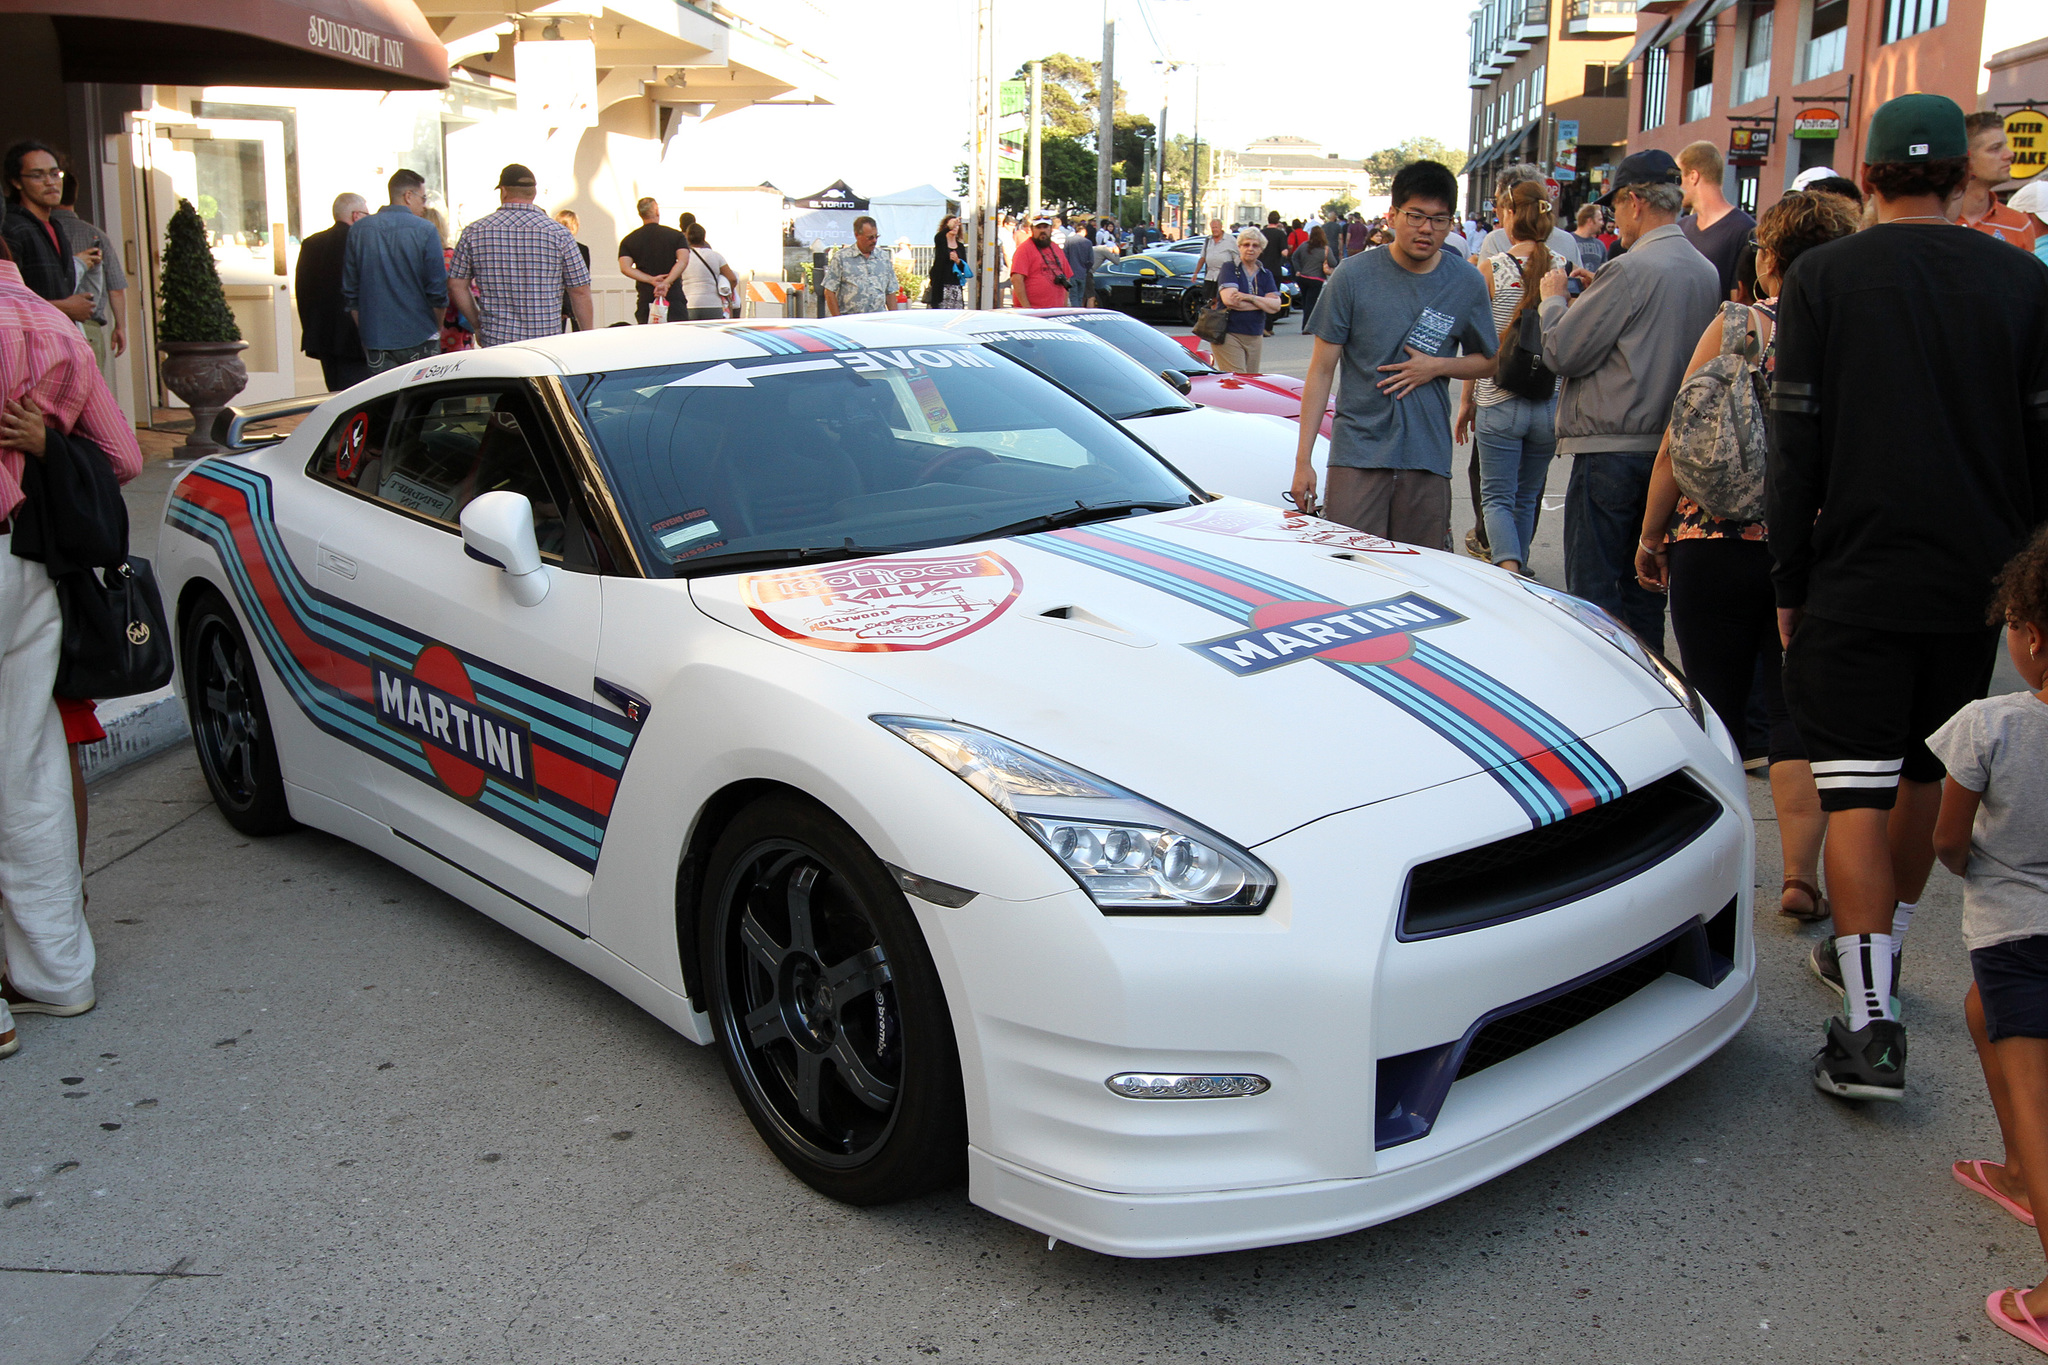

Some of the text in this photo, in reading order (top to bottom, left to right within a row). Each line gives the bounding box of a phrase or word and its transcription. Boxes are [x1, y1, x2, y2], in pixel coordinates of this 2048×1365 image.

[308, 15, 404, 69] SPINDRIFT INN
[2006, 122, 2043, 133] AFTER
[2013, 137, 2034, 148] THE
[2011, 151, 2047, 165] UAKE
[821, 201, 855, 209] TORITO
[425, 363, 453, 378] Sexy
[651, 508, 709, 532] STEVENS CREEK
[676, 540, 724, 560] NISSAN
[899, 562, 977, 579] OCT
[820, 580, 950, 607] RALLY
[809, 610, 890, 633] HOLLYWOOD
[864, 612, 954, 629] WELCOME
[876, 626, 902, 636] LAS
[905, 620, 955, 632] VEGAS
[1208, 601, 1442, 667] MARTINI
[379, 670, 524, 780] MARTINI
[877, 1006, 887, 1057] brembo
